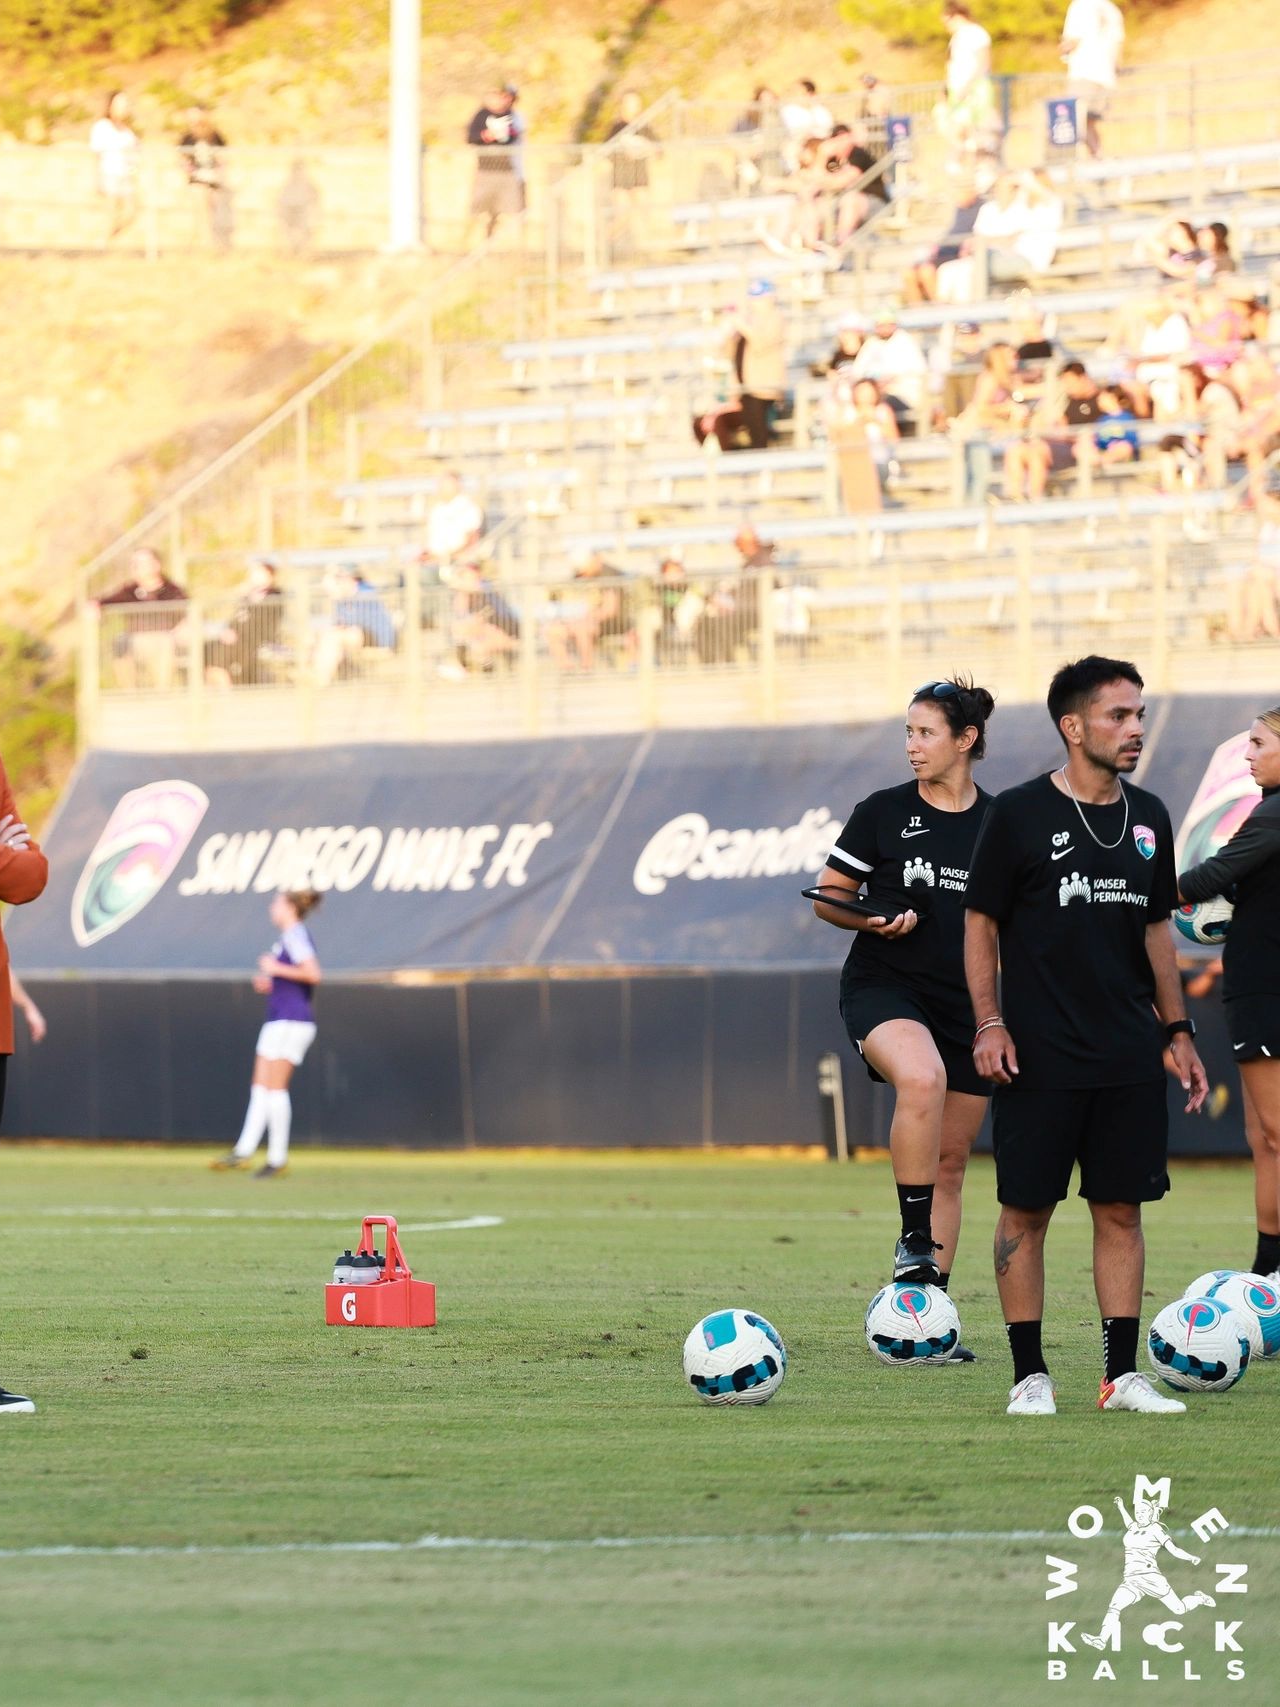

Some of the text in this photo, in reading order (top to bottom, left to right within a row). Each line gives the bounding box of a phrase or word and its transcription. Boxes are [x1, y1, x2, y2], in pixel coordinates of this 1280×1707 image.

[908, 816, 922, 828] JZ
[1052, 831, 1070, 847] GP
[482, 820, 554, 889] FC
[1093, 878, 1127, 890] KAISER
[341, 1292, 357, 1322] G
